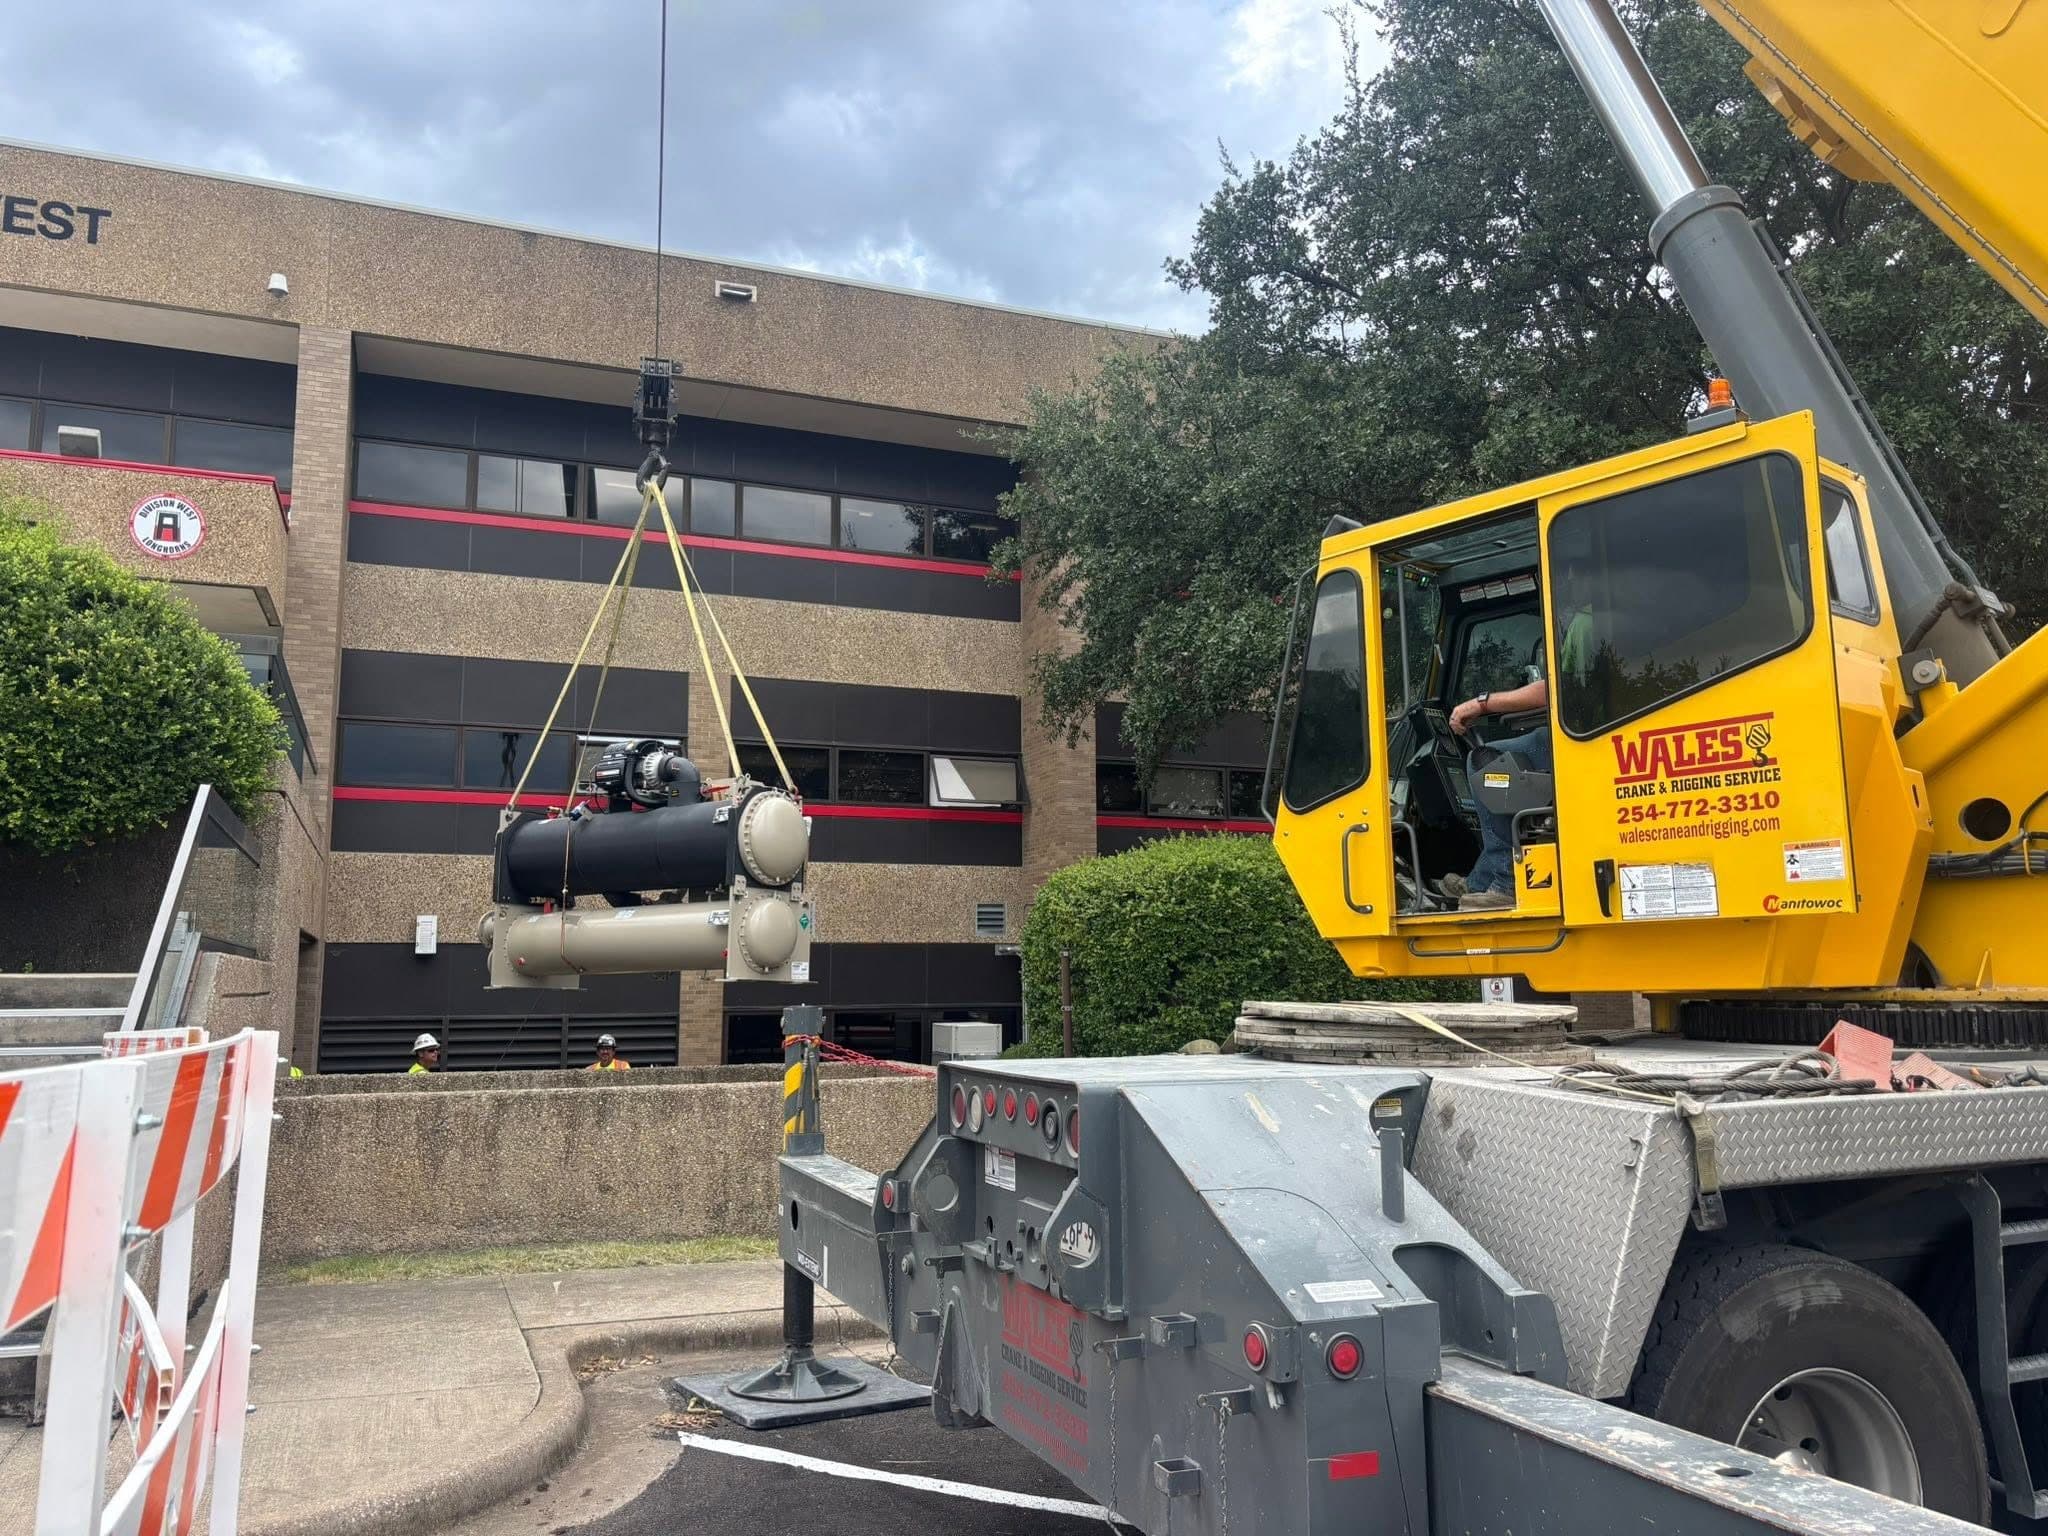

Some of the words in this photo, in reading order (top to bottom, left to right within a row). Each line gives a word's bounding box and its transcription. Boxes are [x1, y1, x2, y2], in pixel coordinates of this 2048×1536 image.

[0, 195, 112, 245] EST
[139, 499, 175, 518] DIVISION
[176, 502, 197, 521] WEST
[142, 536, 192, 554] LONGHORNS
[1612, 726, 1743, 780] WALES
[1616, 783, 1655, 800] CRANE
[1659, 781, 1667, 794] &
[1671, 775, 1721, 793] RIGGING
[1725, 768, 1781, 787] SERVICE
[1617, 791, 1780, 824] 254-772-3310
[1619, 816, 1780, 845] walescraneandrigging.com
[1763, 895, 1843, 913] Manitowoc
[1057, 1375, 1088, 1409] SERVICE
